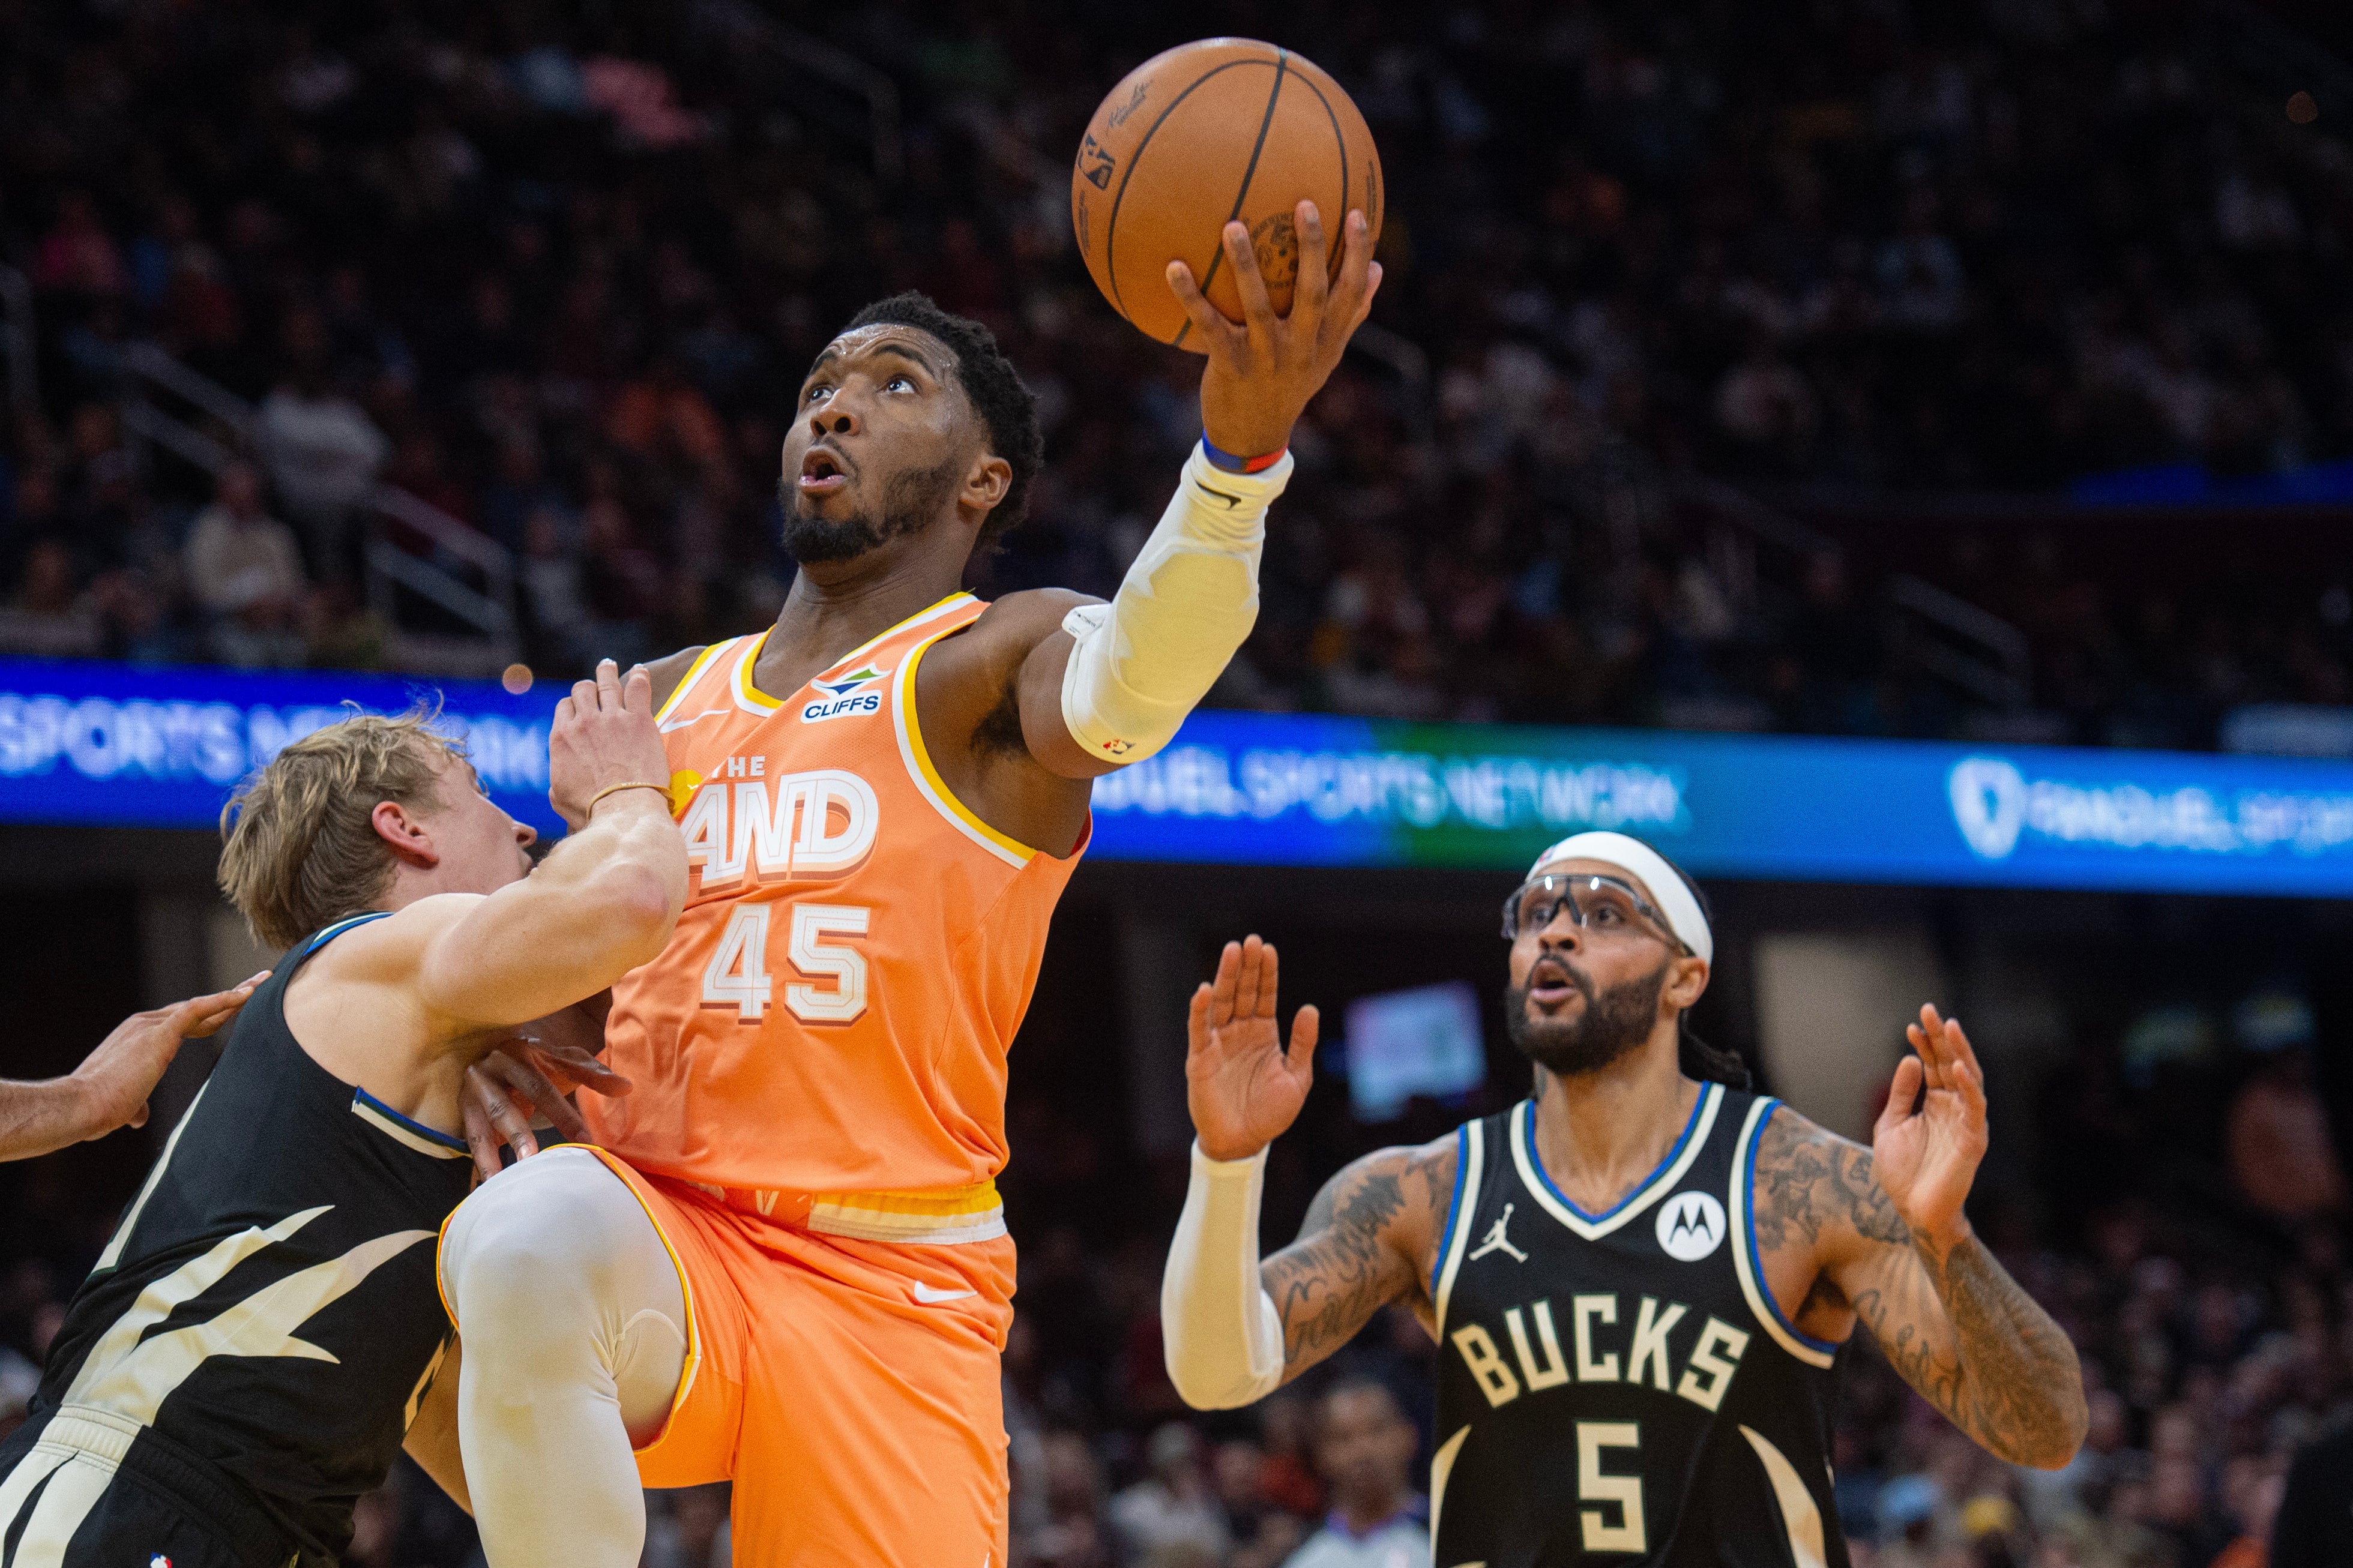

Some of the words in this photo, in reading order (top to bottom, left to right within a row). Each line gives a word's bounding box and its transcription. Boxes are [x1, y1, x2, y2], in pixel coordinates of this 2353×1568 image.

[711, 755, 766, 779] HE
[805, 695, 879, 719] CLIFFS
[679, 769, 879, 896] AND
[700, 902, 871, 1027] 45
[1450, 1293, 1751, 1414] BUCKS
[1575, 1421, 1647, 1554] 5
